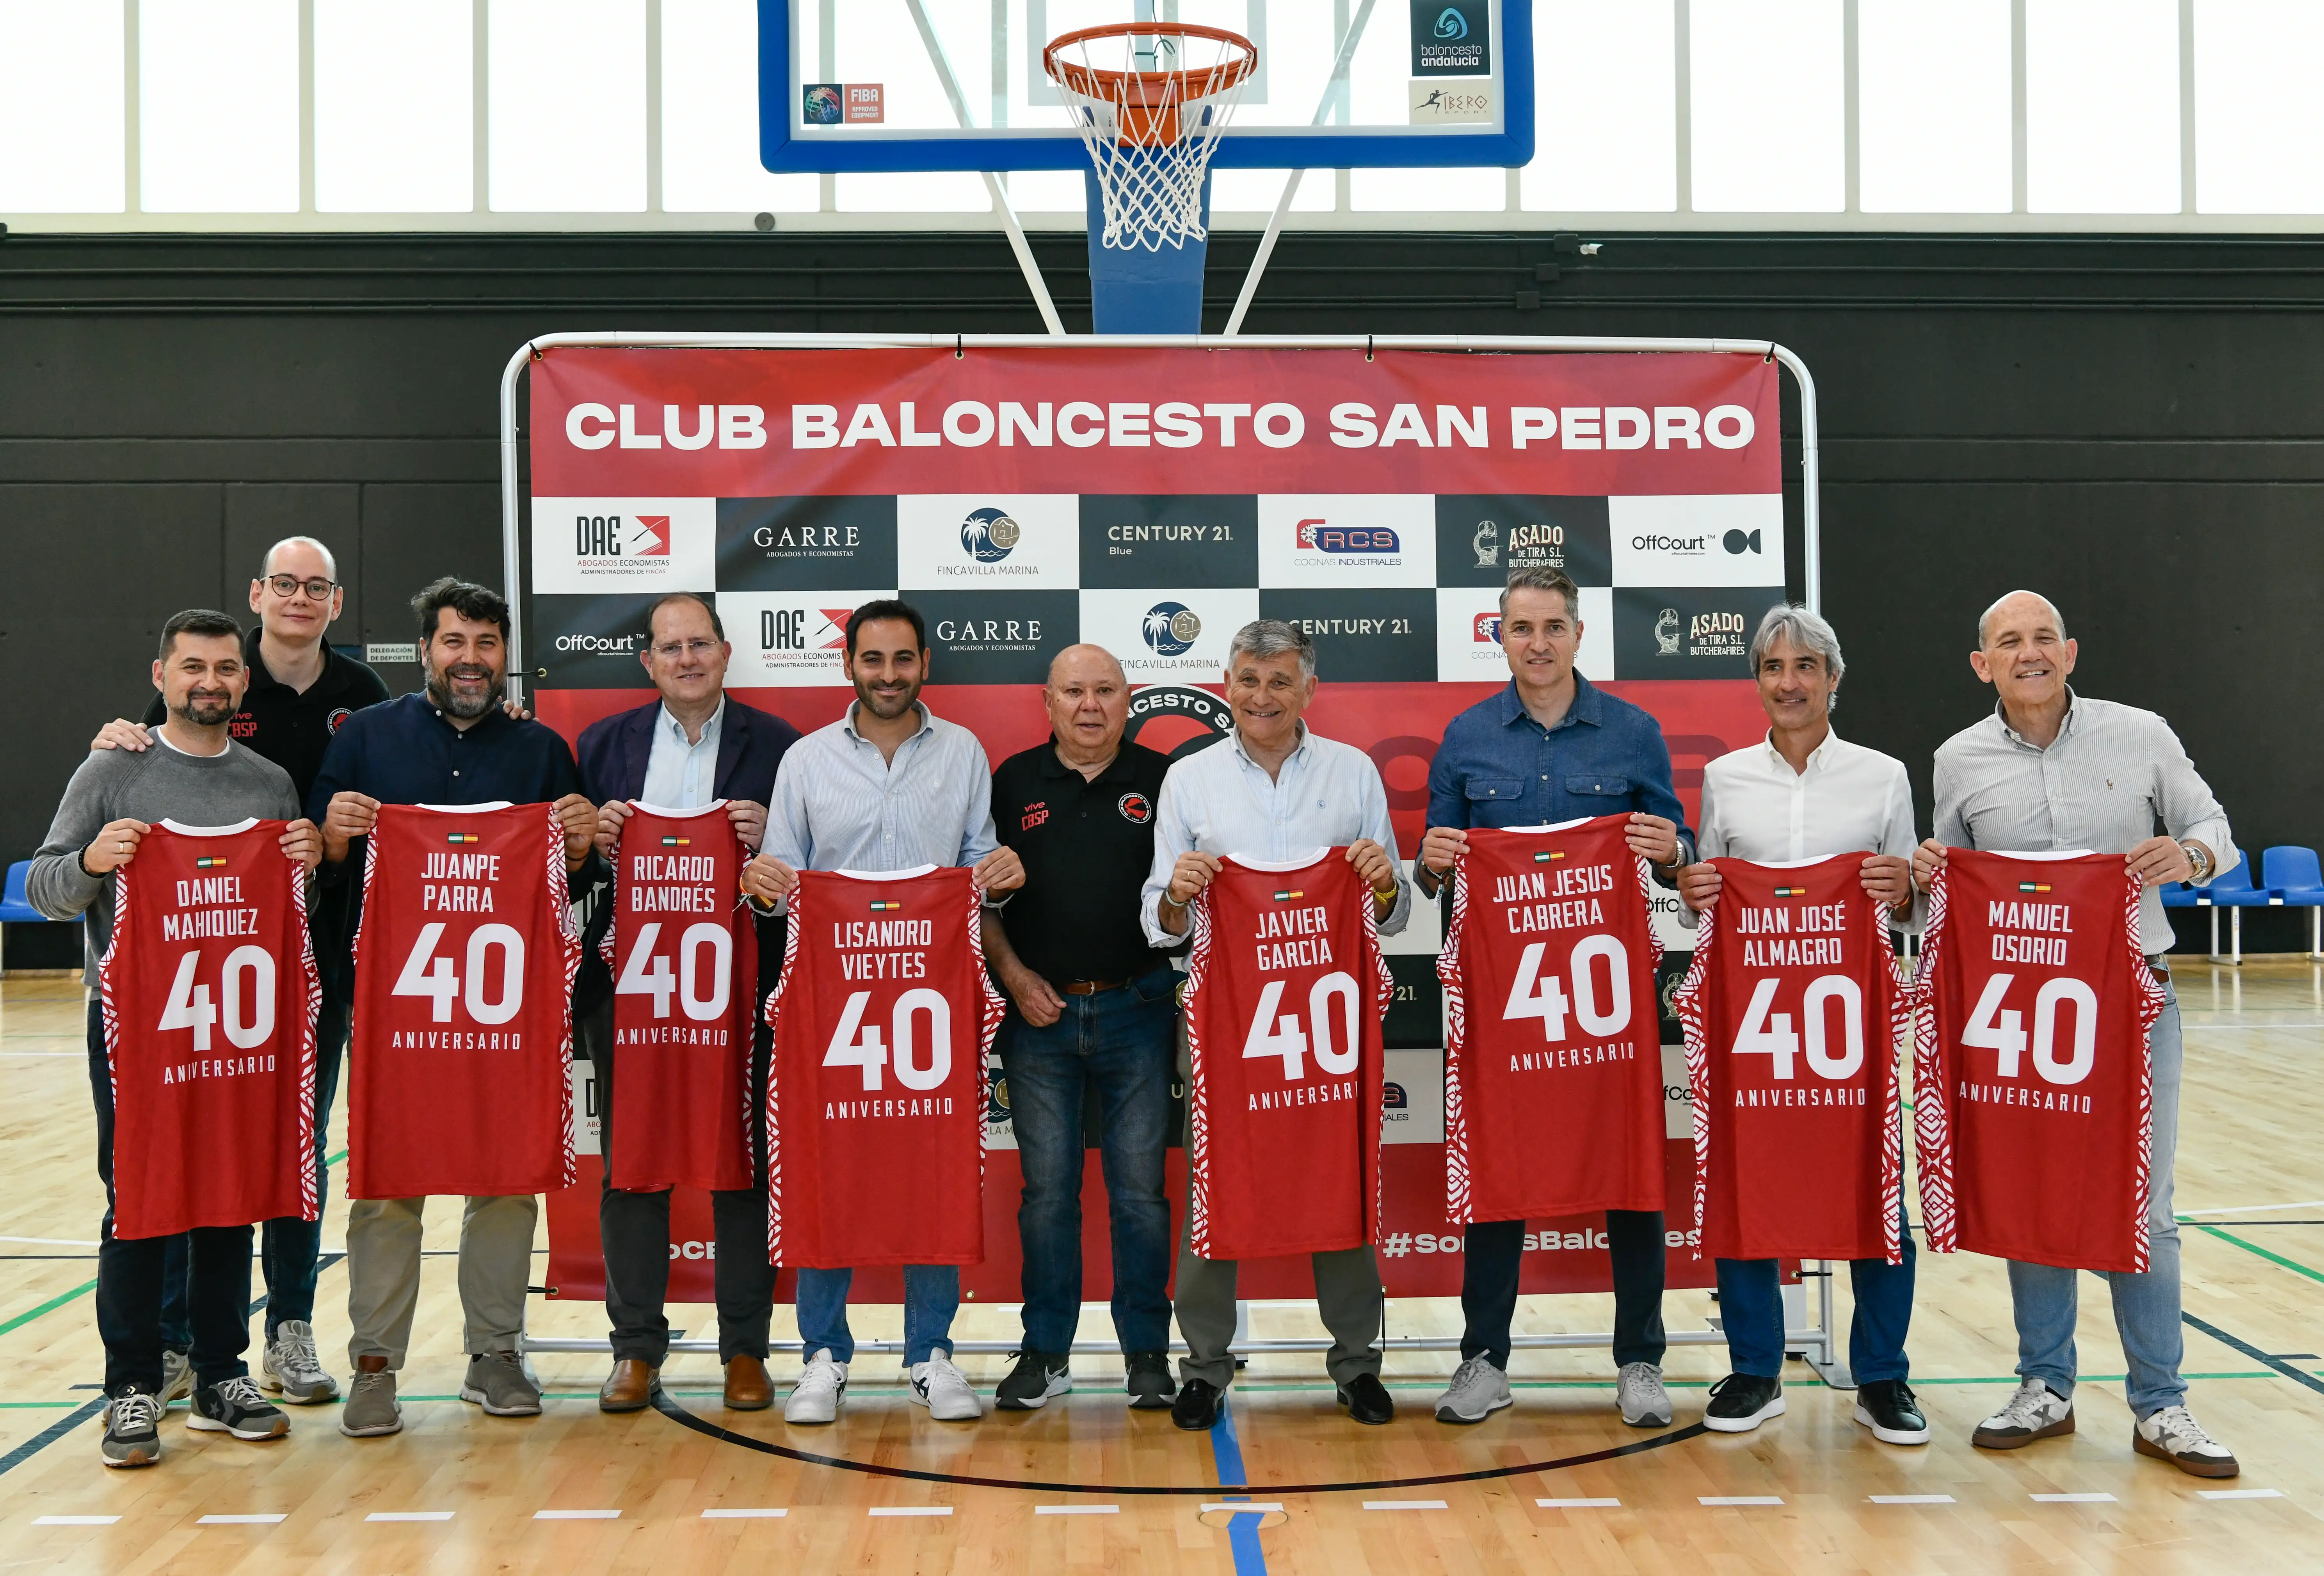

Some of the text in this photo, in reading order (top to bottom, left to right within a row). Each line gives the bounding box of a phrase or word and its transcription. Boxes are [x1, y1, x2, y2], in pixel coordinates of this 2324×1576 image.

[1421, 44, 1482, 56] baloncesto
[1421, 55, 1479, 66] andalucía
[852, 89, 878, 102] FIBA
[1444, 96, 1487, 110] IBERO
[566, 400, 1755, 450] CLUB BALONCESTO SAN PEDRO
[577, 516, 620, 555] DAE
[754, 527, 859, 547] GARRE
[1108, 526, 1207, 540] CENTURY
[1324, 531, 1393, 549] RCS
[1508, 524, 1564, 552] ASADO
[1632, 535, 1705, 550] OffCourt
[1527, 547, 1546, 557] TIRA
[1549, 547, 1564, 557] S.L.
[999, 566, 1038, 574] MARINA
[761, 610, 804, 649] DAE
[937, 621, 1041, 640] GARRE
[1690, 612, 1744, 640] ASADO
[1708, 635, 1727, 645] TIRA
[1730, 634, 1745, 645] S.L.
[556, 635, 633, 650] OffCourt
[1690, 647, 1745, 655] BUTCHER&FIRES
[1181, 660, 1220, 668] MARINA
[329, 710, 350, 724] BALONCESTO
[1127, 694, 1211, 718] CESTO
[1024, 802, 1045, 812] vive
[1120, 794, 1143, 806] BALONCESTO
[1022, 810, 1049, 831] CBSP
[421, 853, 500, 881] JUANPE
[635, 856, 714, 881] RICARDO
[177, 877, 244, 907] DANIEL
[632, 883, 715, 912] BANDRÉS
[1493, 864, 1613, 903] JUAN JESUS
[424, 885, 493, 912] PARRA
[164, 908, 258, 941] MAHIQUEZ
[1255, 906, 1328, 938] JAVIER
[1507, 898, 1604, 933] CABRERA
[1737, 900, 1846, 933] JUAN JOSÉ
[1989, 901, 2073, 933] MANUEL
[835, 920, 931, 948] LISANDRO
[1257, 935, 1332, 970] GARCÍA
[1744, 938, 1842, 966] ALMAGRO
[1992, 934, 2066, 966] OSORIO
[391, 923, 525, 1024] 40
[615, 922, 733, 1021] 40
[841, 952, 925, 980] VIEYTES
[158, 945, 275, 1051] 40
[1503, 934, 1631, 1042] 40
[617, 1027, 727, 1045] ANIVERSARIO
[822, 988, 951, 1091] 40
[1242, 971, 1359, 1080] 40
[1732, 975, 1863, 1079] 40
[1960, 973, 2097, 1085] 40
[393, 1032, 520, 1049] ANIVERSARIO
[165, 1055, 274, 1084] ANIVERSARIO
[1510, 1042, 1633, 1071] ANIVERSARIO
[826, 1098, 951, 1119] ANIVERSARIO
[1249, 1081, 1357, 1110] ANIVERSARI
[1735, 1089, 1865, 1107] ANIVERSARIO
[1959, 1081, 2090, 1113] ANIVERSARIO
